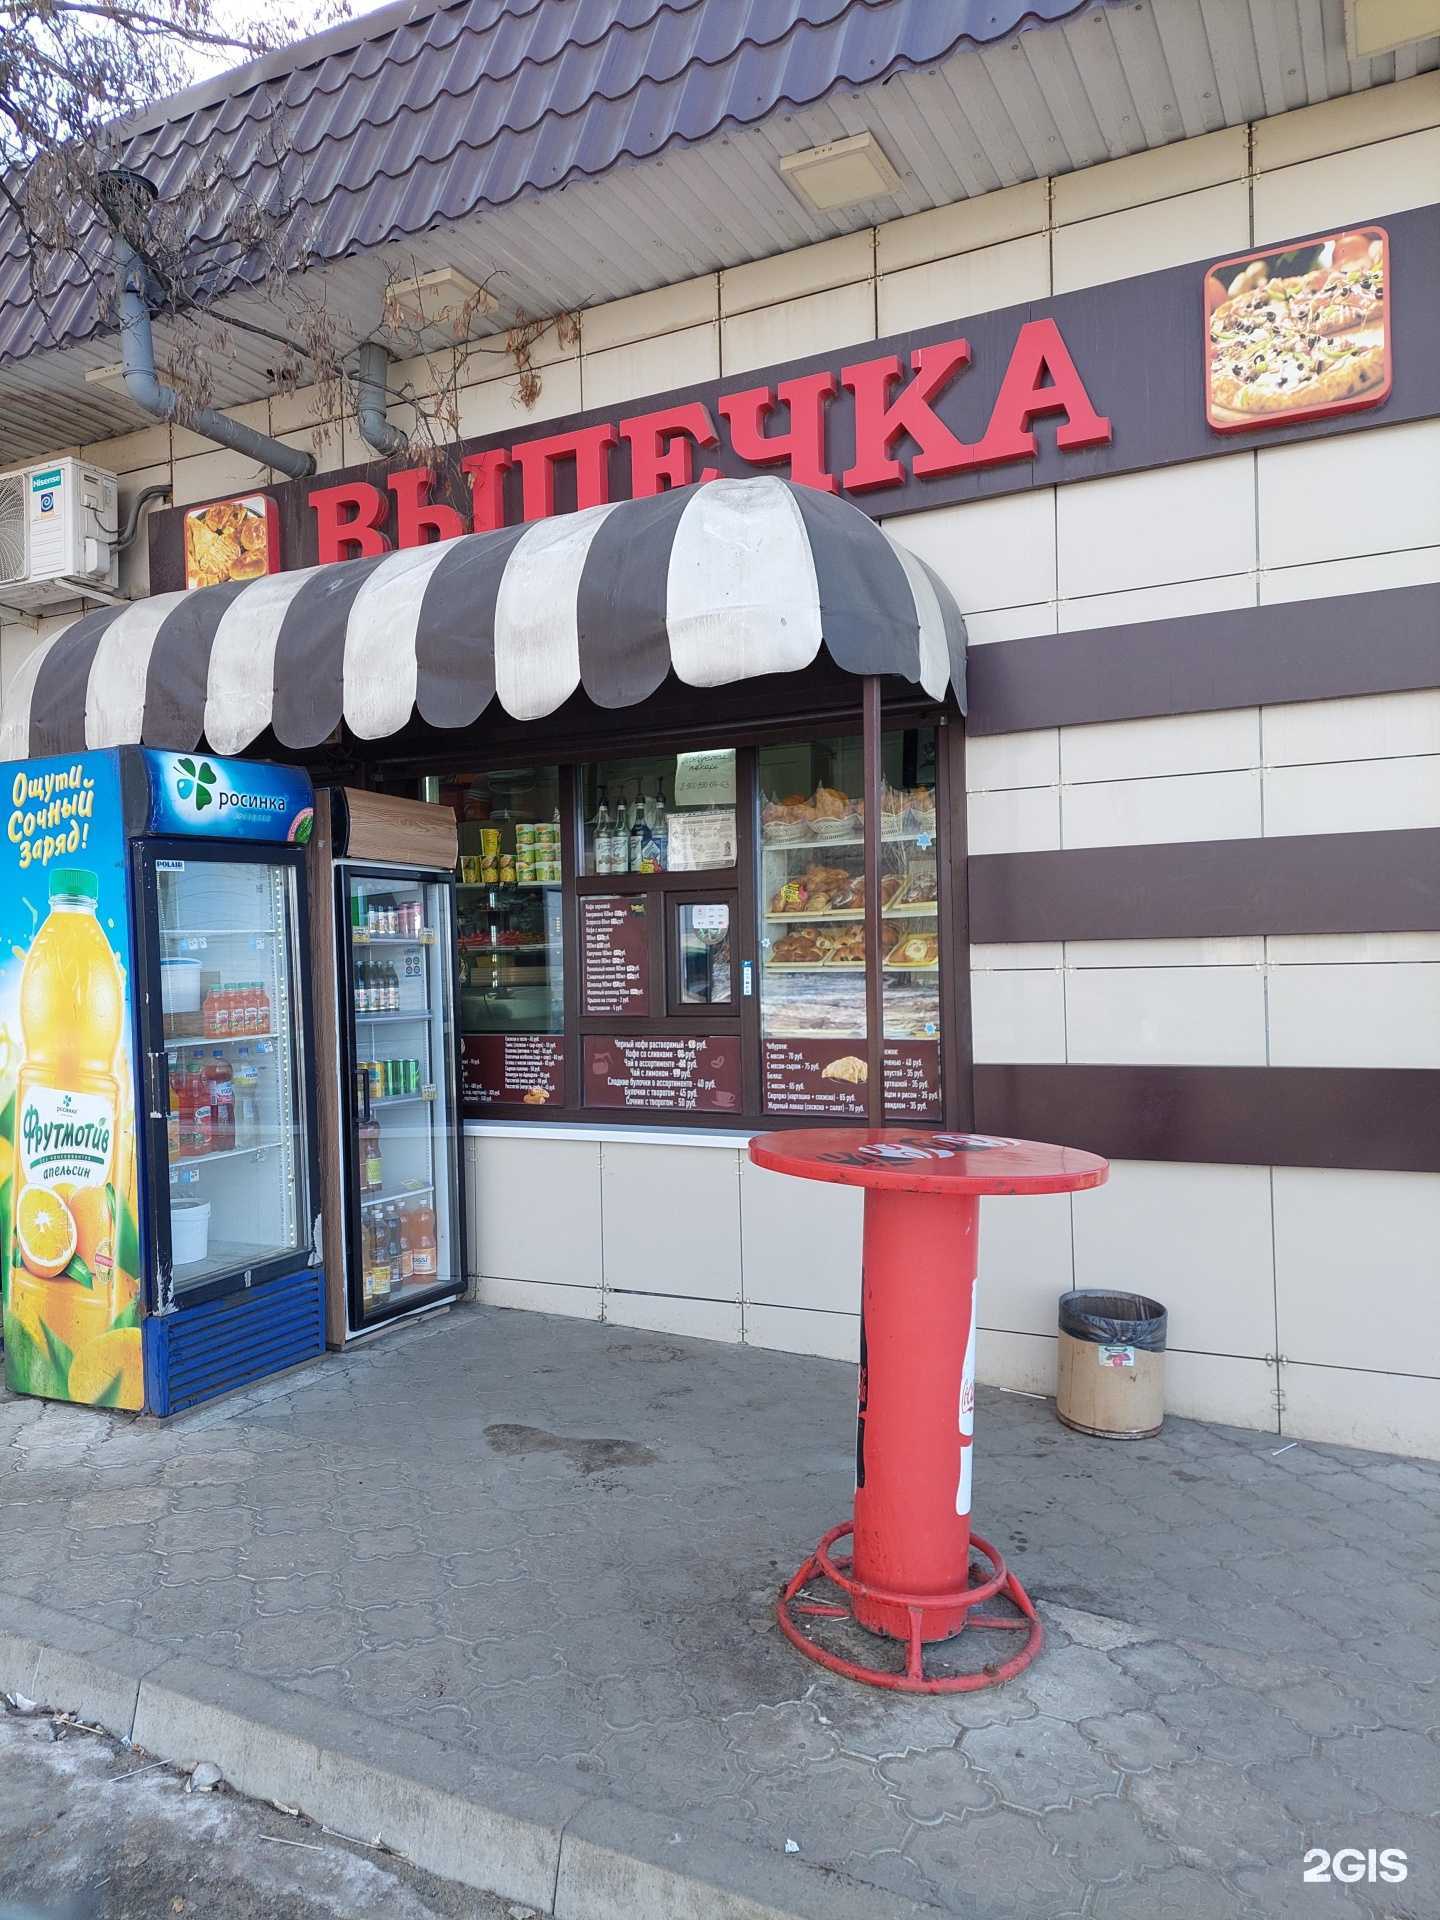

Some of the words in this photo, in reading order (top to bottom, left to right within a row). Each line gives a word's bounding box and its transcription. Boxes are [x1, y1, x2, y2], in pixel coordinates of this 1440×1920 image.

[308, 318, 1112, 565] ВЫПЕЧКА
[33, 475, 60, 487] Hisense
[13, 764, 82, 807] Ощути
[219, 791, 286, 811] росинка
[8, 779, 94, 842] Сочный
[23, 1104, 110, 1155] Фрутмотив
[43, 1164, 91, 1180] апельсин
